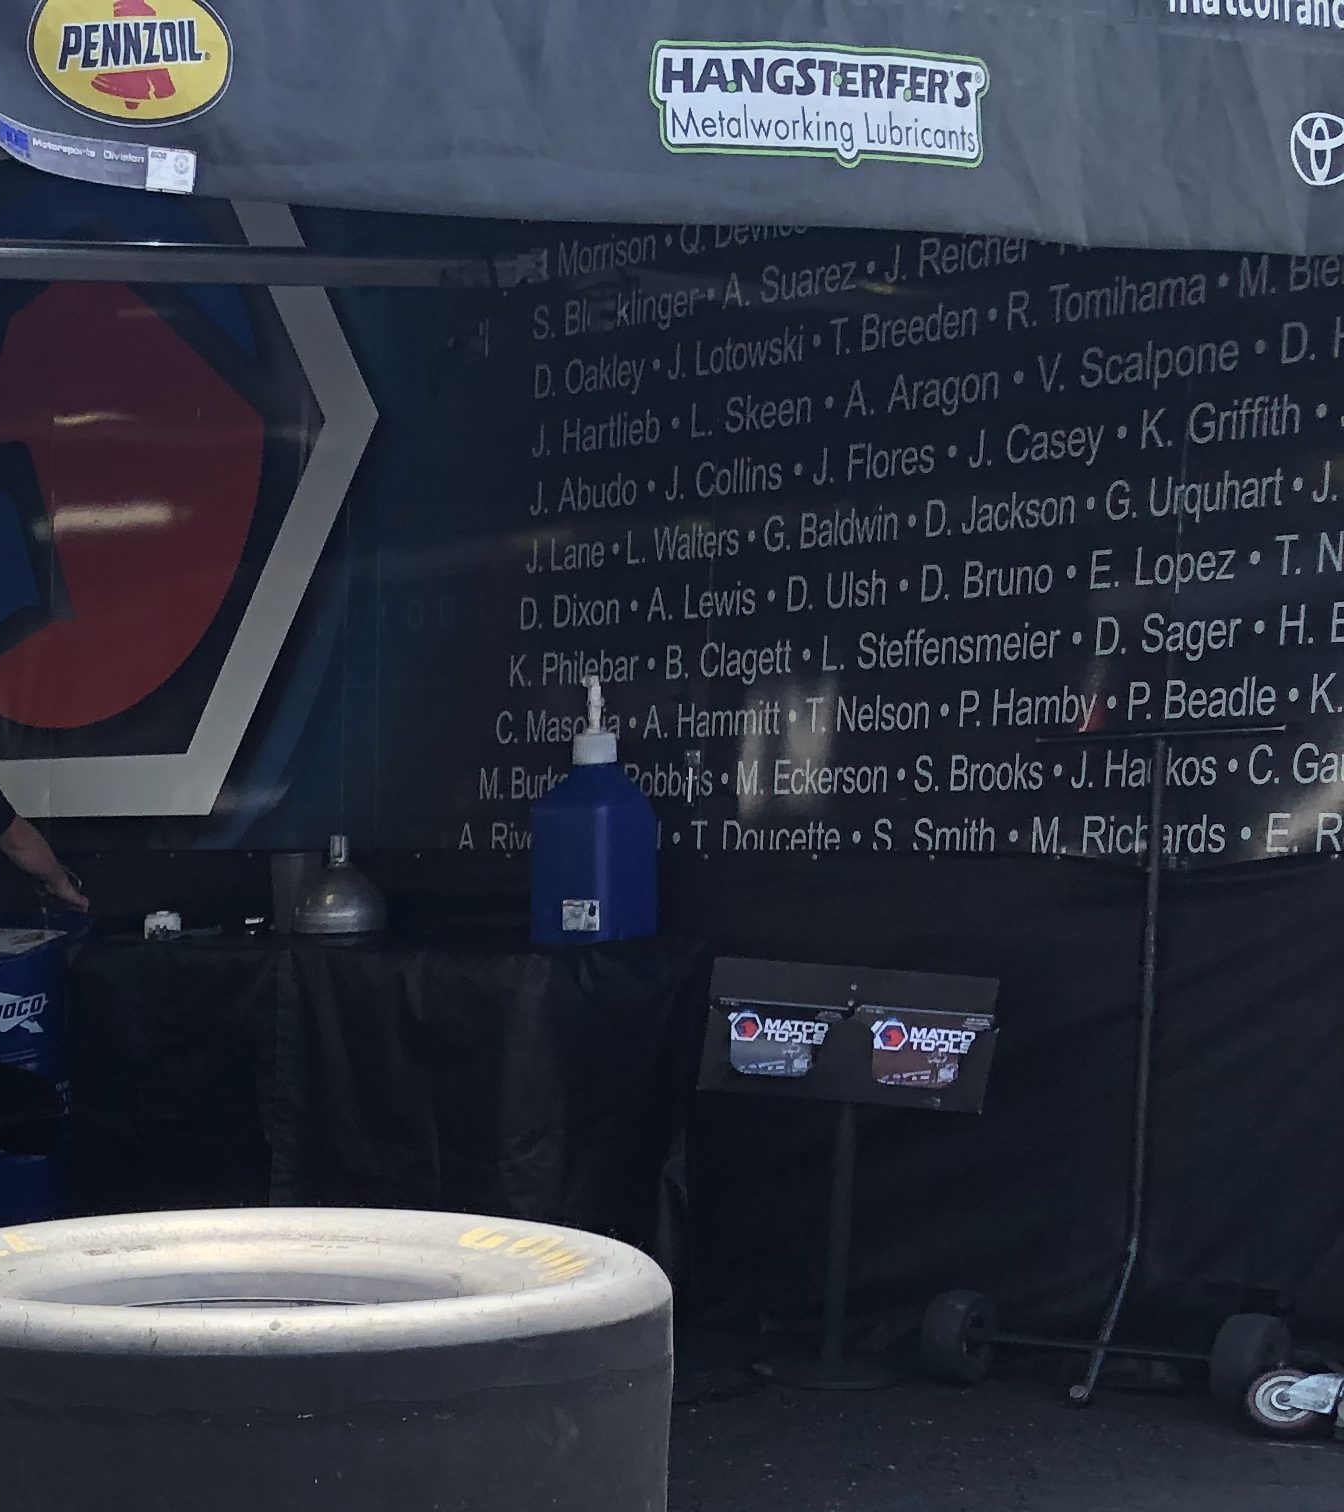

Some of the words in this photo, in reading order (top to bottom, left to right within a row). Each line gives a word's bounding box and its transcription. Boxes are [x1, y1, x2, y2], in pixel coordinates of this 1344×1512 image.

[58, 20, 203, 70] PENNZOIL
[662, 57, 972, 108] HANGSTERFER'S
[32, 138, 96, 158] Motorsports
[103, 150, 145, 163] Division
[672, 104, 854, 151] Metalworking
[864, 112, 976, 153] Lubricants
[533, 304, 556, 340] S.
[723, 273, 749, 310] A.
[761, 260, 857, 303] Suarez
[884, 244, 906, 284] J.
[535, 364, 556, 399] D.
[566, 355, 645, 395] Oakley
[668, 344, 685, 380] J.
[696, 326, 804, 377] Lotowski
[831, 317, 850, 355] T.
[862, 302, 977, 352] Breeden
[1007, 291, 1036, 331] R.
[1050, 274, 1206, 323] Tomihama
[1239, 257, 1276, 298] M.
[533, 424, 550, 457] J.
[563, 409, 660, 453] Hartlieb
[691, 403, 712, 438] L.
[726, 396, 811, 433] Skeen
[844, 380, 874, 418] A.
[887, 370, 998, 416] Aragon
[1038, 353, 1064, 393] V.
[1080, 340, 1238, 390] Scalpone
[1281, 321, 1315, 364] D.
[530, 481, 547, 516] J.
[558, 473, 637, 513] Abudo
[665, 465, 683, 500] J.
[696, 457, 782, 498] Collins
[813, 448, 833, 486] J.
[848, 440, 934, 482] Flores
[969, 430, 992, 469] J.
[1007, 422, 1104, 466] Casey
[1141, 408, 1172, 449] K.
[1188, 395, 1300, 444] Griffith
[526, 541, 544, 574] J.
[551, 539, 604, 572] Lane
[626, 531, 645, 564] L.
[655, 523, 739, 561] Walters
[764, 514, 790, 551] G.
[800, 505, 897, 550] Baldwin
[925, 500, 951, 537] D.
[962, 492, 1075, 534] Jackson
[1105, 480, 1136, 519] G.
[1149, 467, 1282, 522] Urquhart
[1312, 460, 1336, 503] J.
[520, 597, 541, 630] D.
[553, 594, 619, 628] Dixon
[647, 587, 673, 622] A.
[684, 581, 755, 619] Lewis
[786, 576, 812, 612] D.
[826, 570, 886, 608] Ulsh
[921, 565, 949, 603] D.
[963, 561, 1053, 598] Bruno
[1090, 549, 1118, 590] E.
[1135, 546, 1236, 594] Lopez
[1275, 534, 1302, 576] T.
[510, 654, 531, 687] K.
[665, 645, 688, 680] B.
[700, 640, 791, 685] Clagett
[822, 636, 844, 672] L.
[857, 622, 1061, 670] Steffensmeier
[1095, 616, 1126, 656] D.
[1141, 613, 1242, 661] Sager
[1279, 603, 1313, 646] H.
[496, 711, 517, 744] C.
[643, 705, 671, 739] A.
[677, 700, 780, 738] Hammitt
[806, 697, 826, 733] T.
[836, 691, 930, 732] Nelson
[959, 690, 981, 728] P.
[993, 686, 1097, 733] Hamby
[1127, 681, 1151, 720] P.
[1165, 676, 1276, 719] Beadle
[1310, 672, 1342, 714] K.
[479, 768, 503, 800] M.
[736, 761, 762, 795] M.
[774, 759, 887, 795] Eckerson
[914, 755, 938, 792] S.
[949, 752, 1043, 791] Brooks
[1071, 750, 1093, 789] J.
[1248, 744, 1279, 785] C.
[913, 816, 995, 851] Smith
[1266, 812, 1298, 853] E.
[764, 1018, 829, 1035] MATCO
[909, 1027, 976, 1044] MATCO
